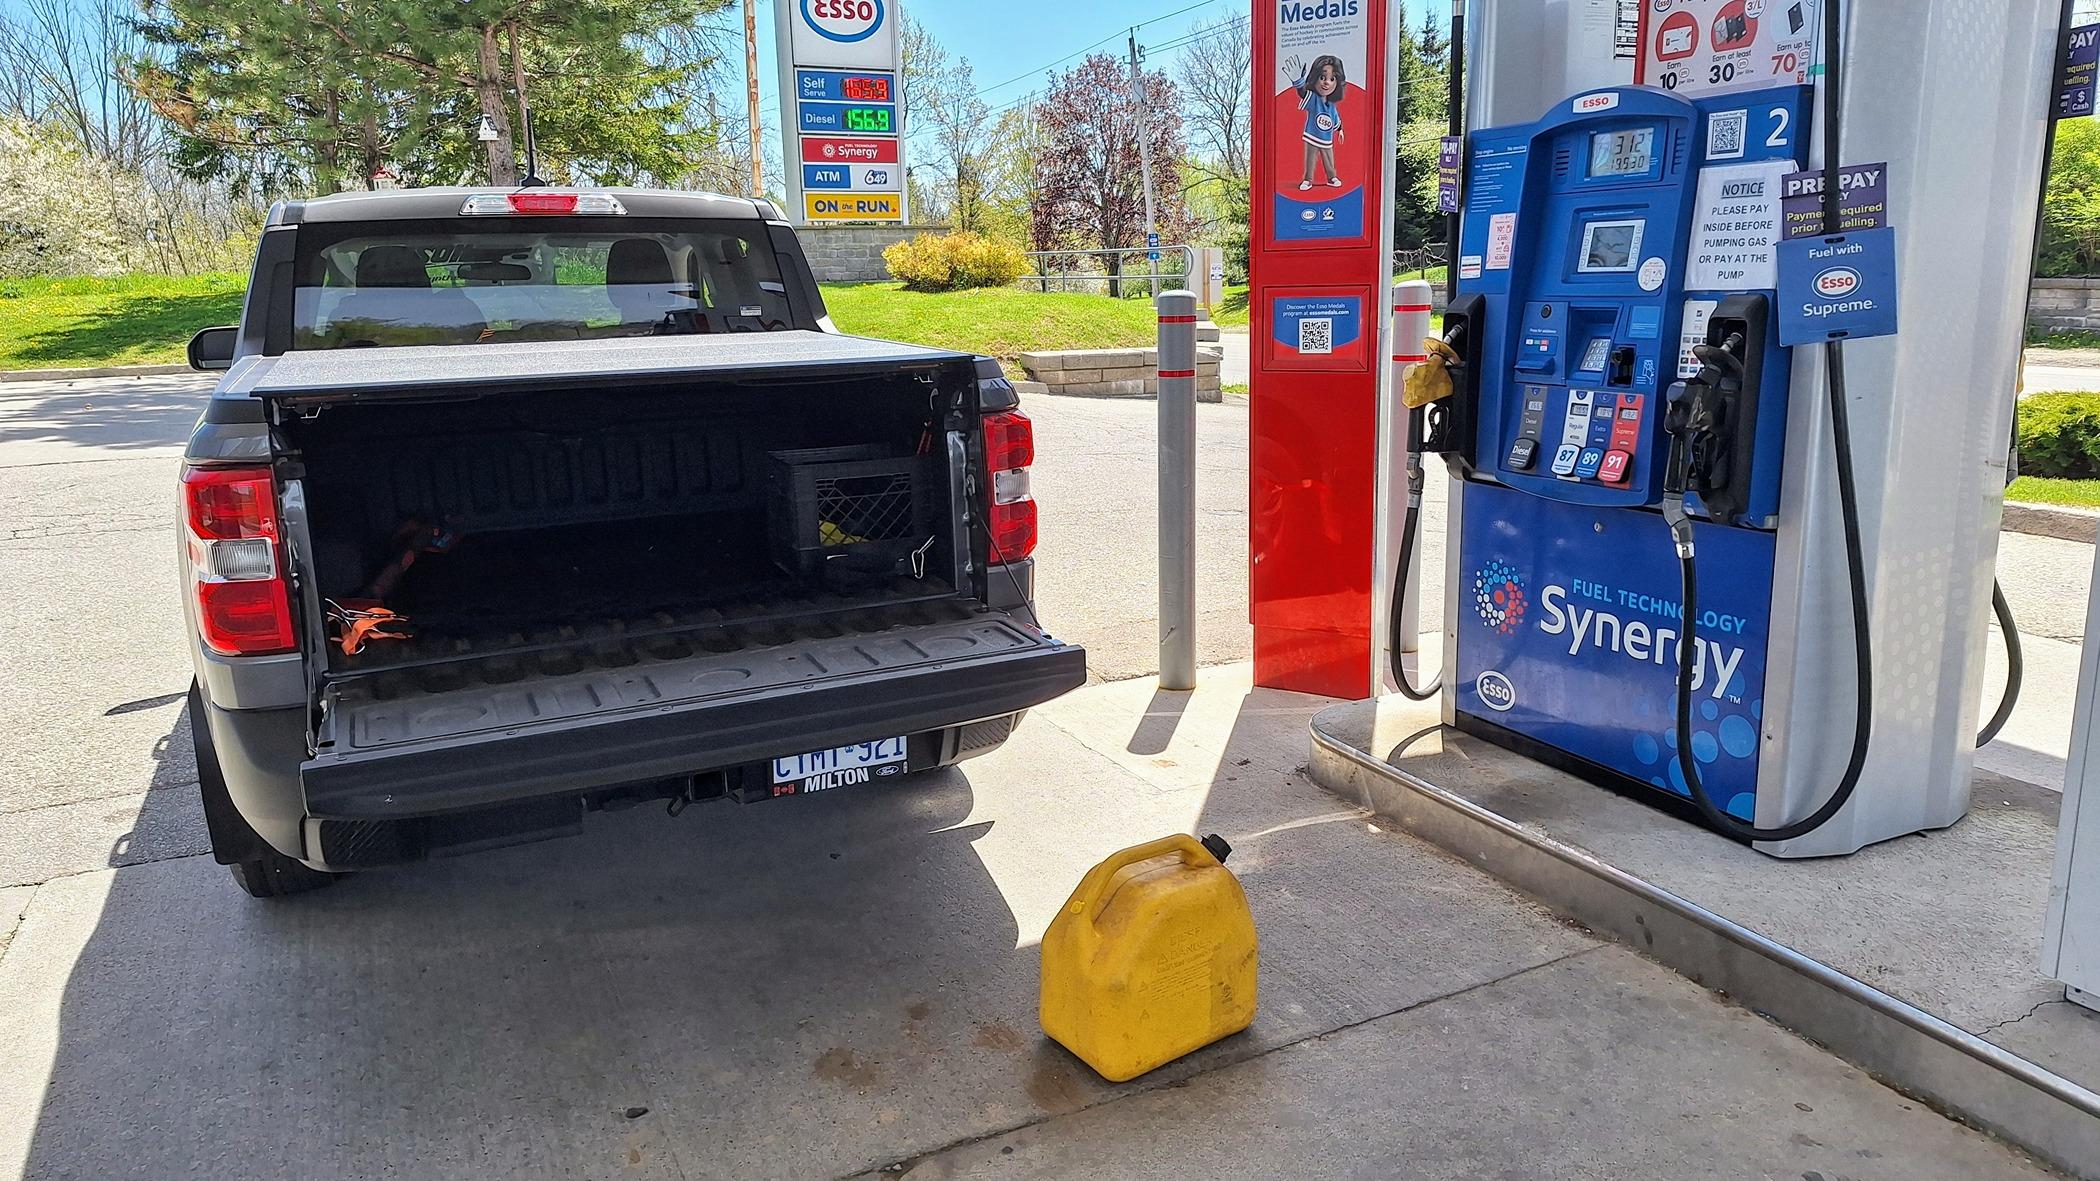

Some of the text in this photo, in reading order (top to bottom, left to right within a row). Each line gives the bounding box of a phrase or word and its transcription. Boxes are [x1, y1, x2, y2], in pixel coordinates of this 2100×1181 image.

[1281, 0, 1358, 24] Medals
[1777, 43, 1792, 51] Earn
[1794, 42, 1802, 50] up
[1713, 54, 1726, 62] Earn
[1771, 53, 1797, 75] 70
[1709, 63, 1734, 84] 30
[803, 77, 825, 89] Self
[1660, 72, 1677, 90] 10
[804, 88, 826, 97] Serve
[1583, 97, 1609, 108] ESSO
[2072, 102, 2089, 110] Cash
[805, 114, 836, 124] Diesel
[1766, 108, 1789, 147] 2
[838, 146, 878, 159] Synergy
[815, 171, 840, 182] ATM
[1721, 182, 1764, 197] NOTICE
[814, 200, 839, 213] ON
[856, 200, 889, 213] RUN
[1711, 204, 1769, 216] PLEASE PAY
[1840, 202, 1883, 216] equired
[1703, 220, 1773, 232] INSIDE BEFORE
[1791, 223, 1817, 235] prior
[1704, 237, 1767, 248] PUMPING GAS
[1809, 242, 1863, 259] Fuel with
[1698, 253, 1768, 264] OR PAY AT THE
[1717, 270, 1744, 280] PUMP
[1821, 276, 1854, 290] Esso
[1803, 300, 1873, 318] Supreme
[1569, 422, 1583, 430] Regular
[1512, 445, 1531, 457] Diesel
[1560, 449, 1575, 462] 87
[1582, 452, 1598, 466] 89
[1607, 455, 1623, 469] 91
[1573, 579, 1611, 602] FUEL
[1540, 585, 1744, 699] Synergy
[1483, 678, 1510, 701] Esso
[804, 767, 870, 793] MILTON
